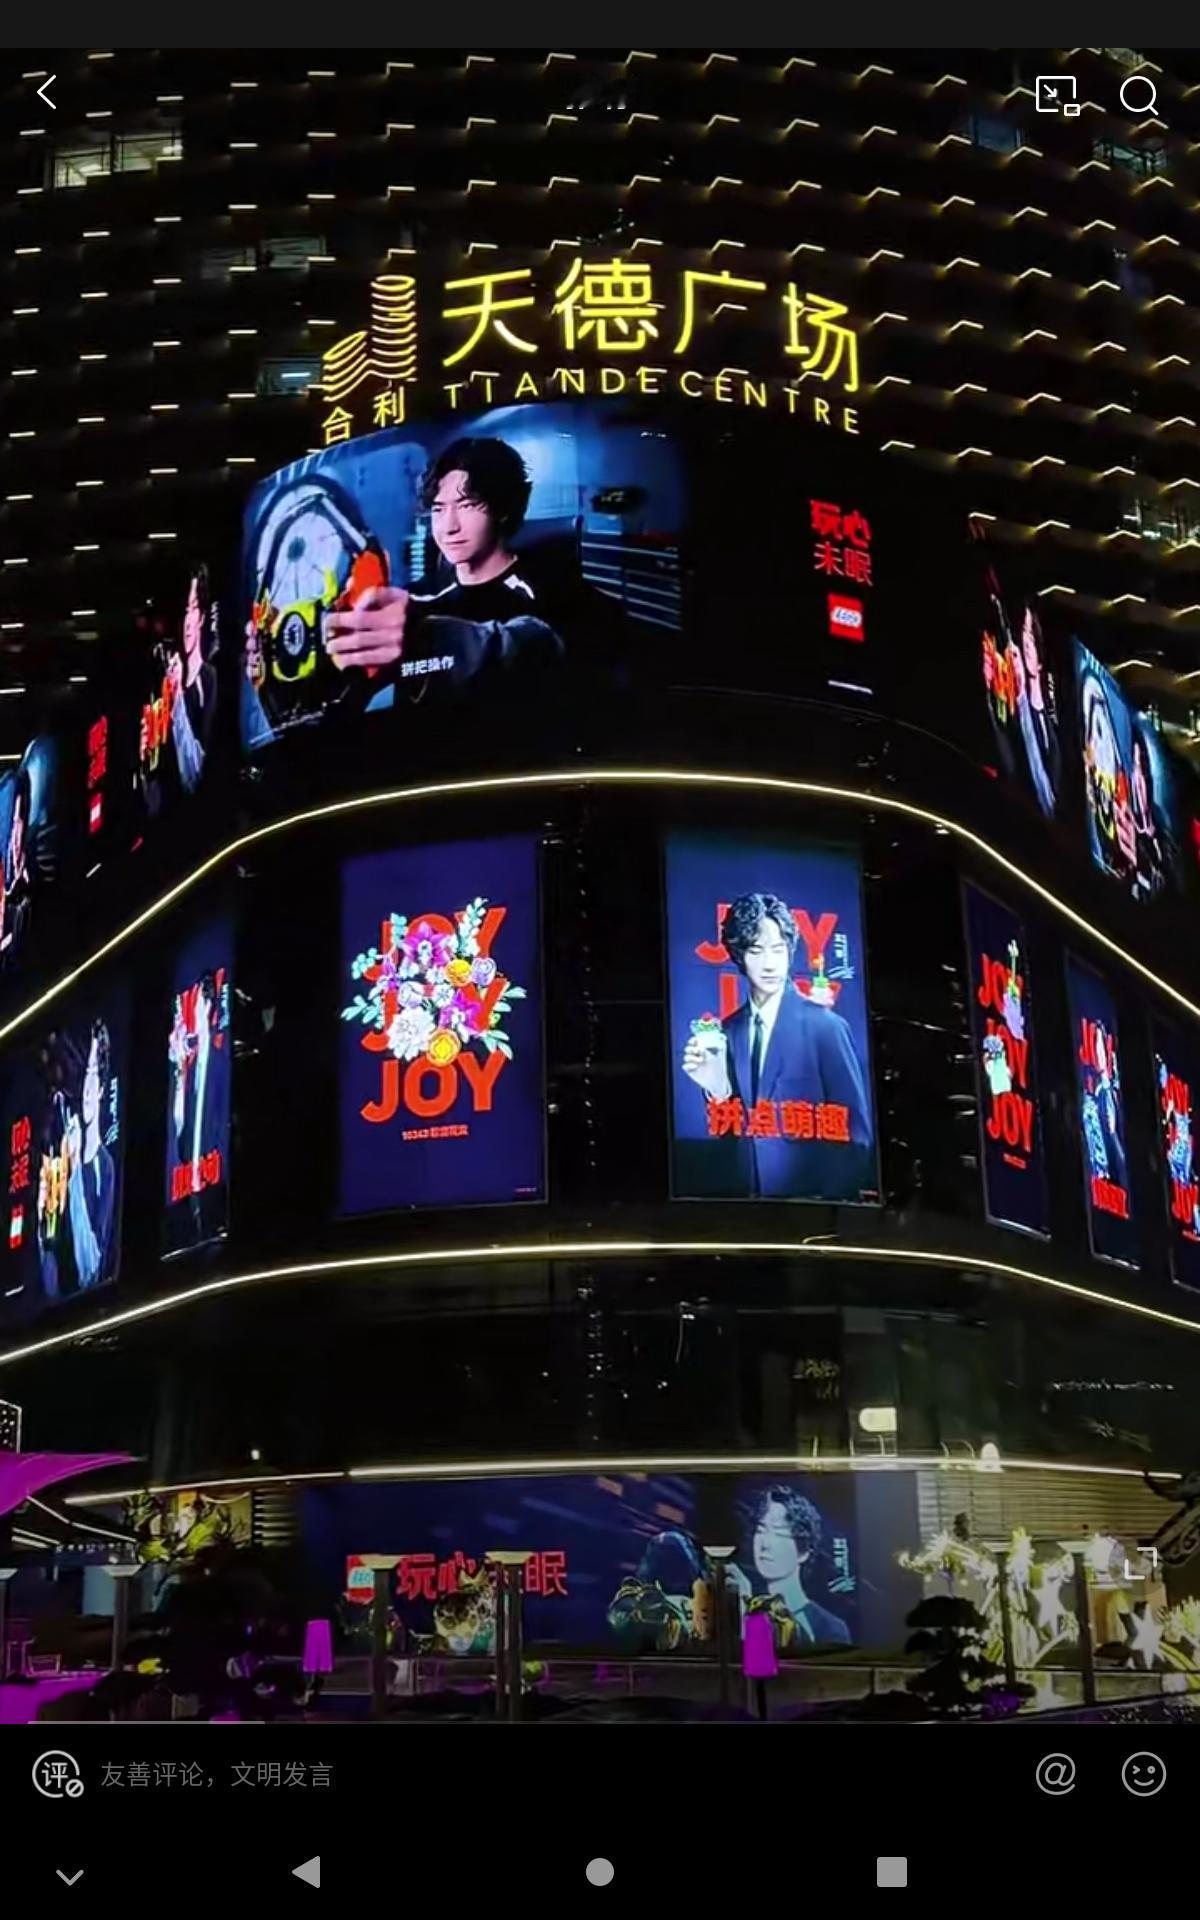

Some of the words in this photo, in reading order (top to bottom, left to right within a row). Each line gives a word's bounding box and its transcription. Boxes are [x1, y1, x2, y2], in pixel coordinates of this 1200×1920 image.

[442, 257, 861, 392] 天德广场
[321, 385, 406, 445] 合利
[810, 499, 872, 549] 玩心
[813, 541, 874, 586] 未眠
[694, 902, 838, 970] JY
[360, 1050, 508, 1123] JOY
[986, 1092, 1033, 1152] JOY
[397, 1551, 568, 1601] 玩心眠
